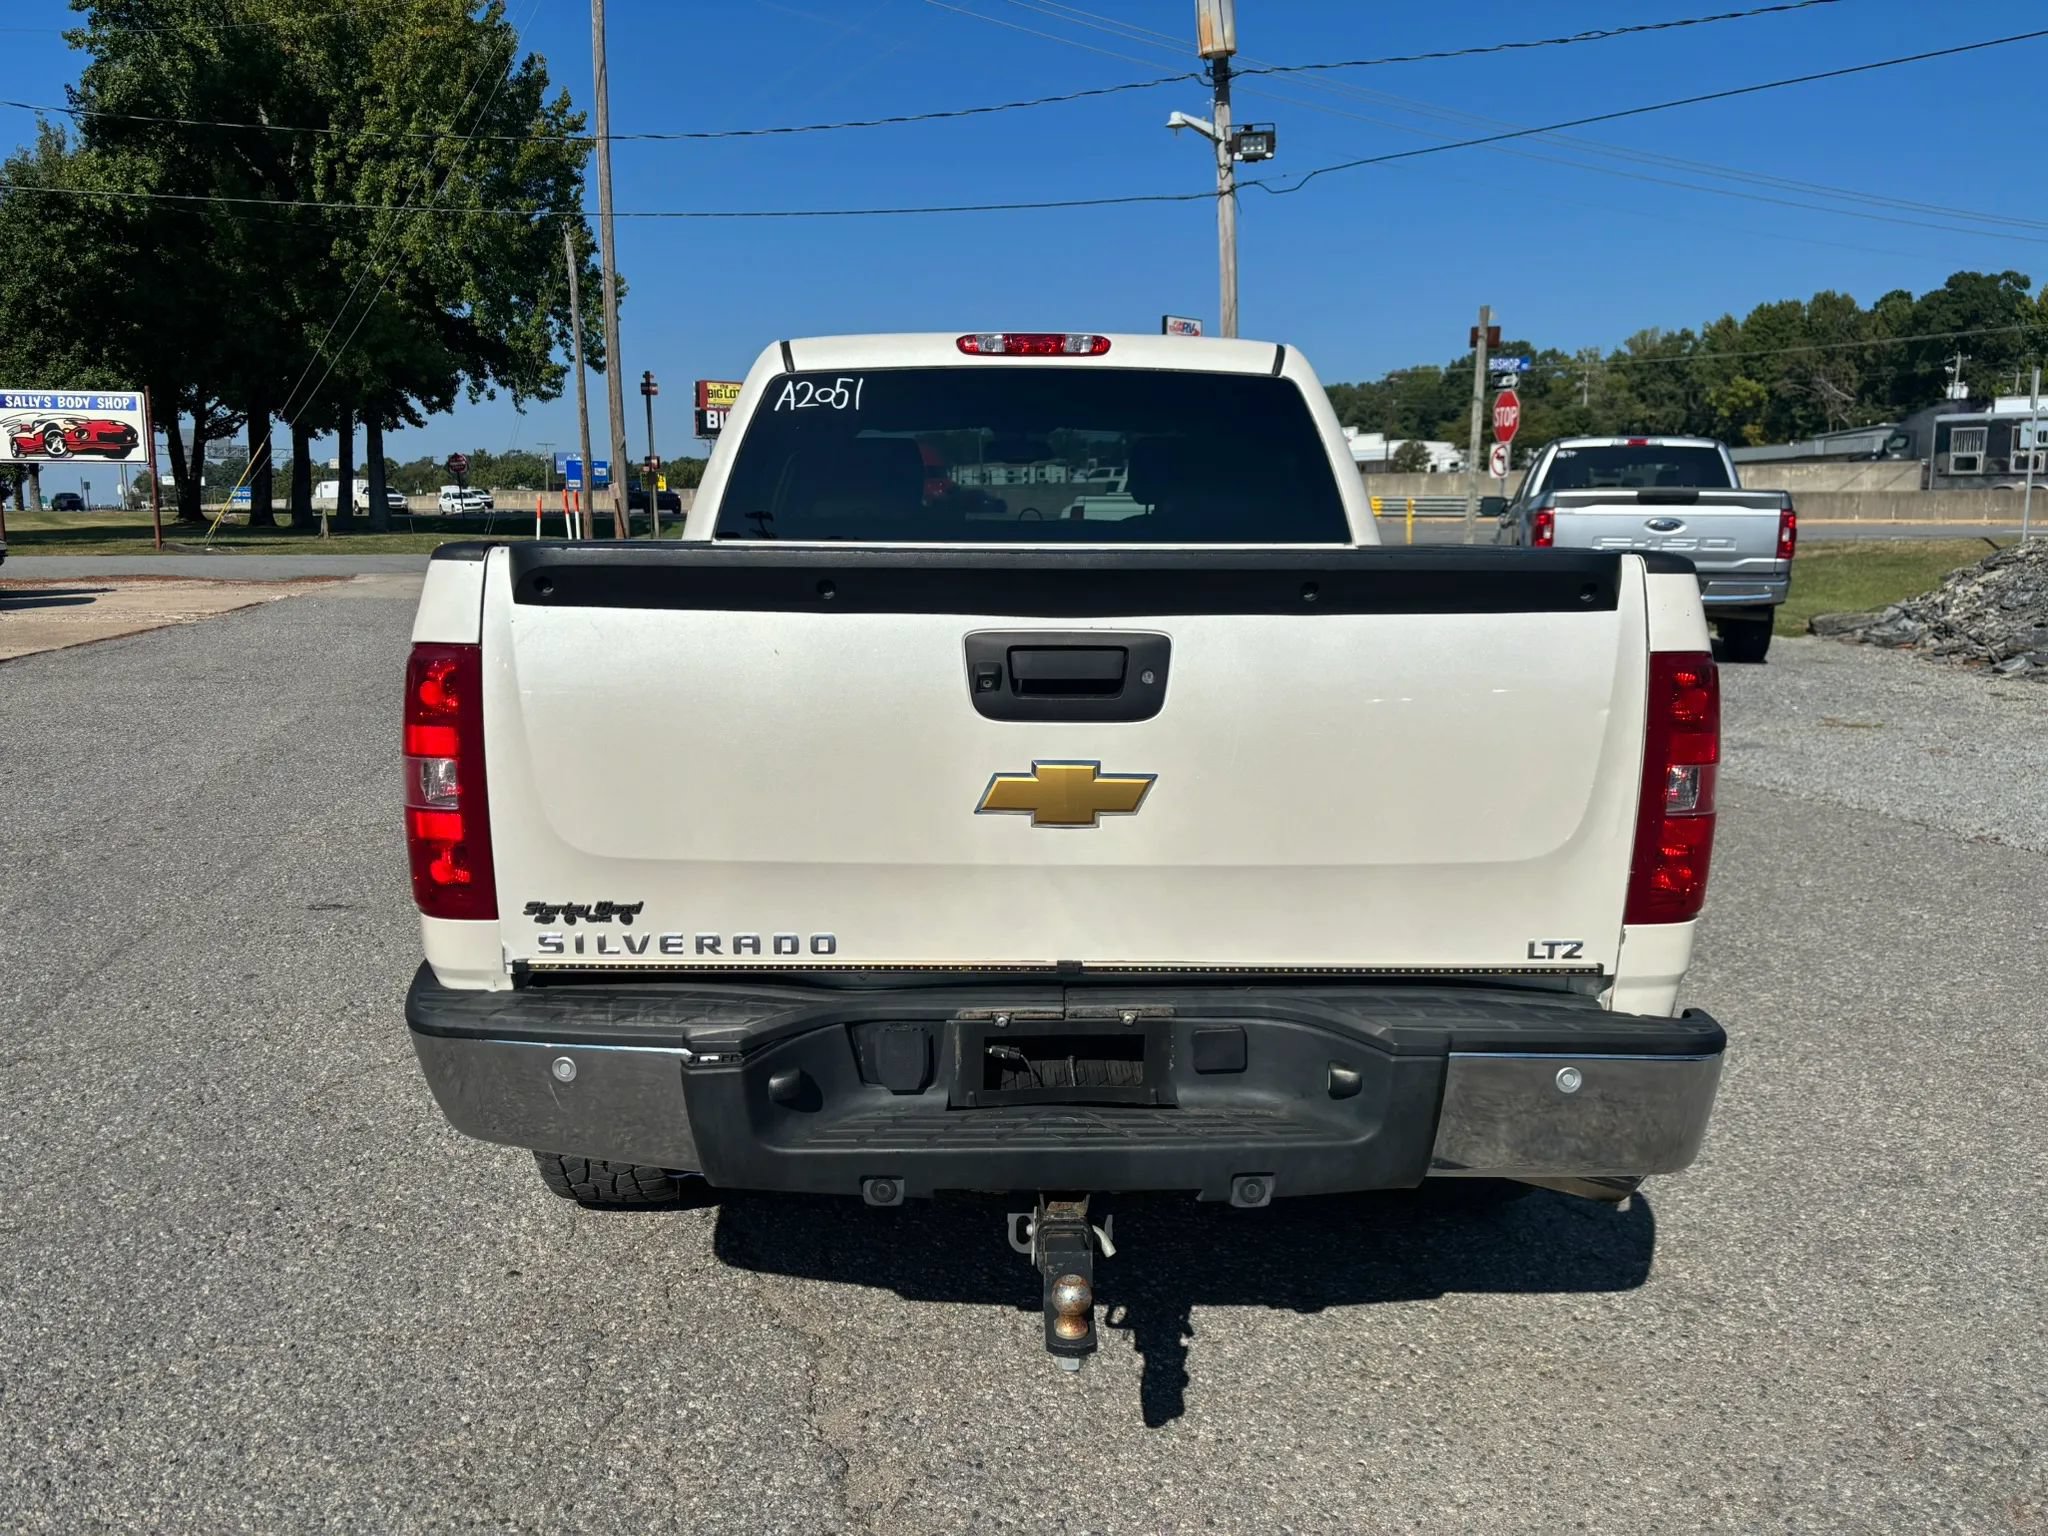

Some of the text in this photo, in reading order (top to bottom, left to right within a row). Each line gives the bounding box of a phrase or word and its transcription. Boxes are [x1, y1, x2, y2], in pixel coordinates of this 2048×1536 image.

[1488, 358, 1520, 370] BISHOP
[5, 395, 130, 409] SALLY'S BODY SHOP
[707, 389, 723, 398] BIG
[773, 377, 864, 412] A2051
[706, 410, 729, 428] BI
[1494, 406, 1518, 427] STOP
[594, 900, 644, 915] Wood
[537, 931, 837, 955] SILVERADO
[1527, 940, 1584, 959] LTZ
